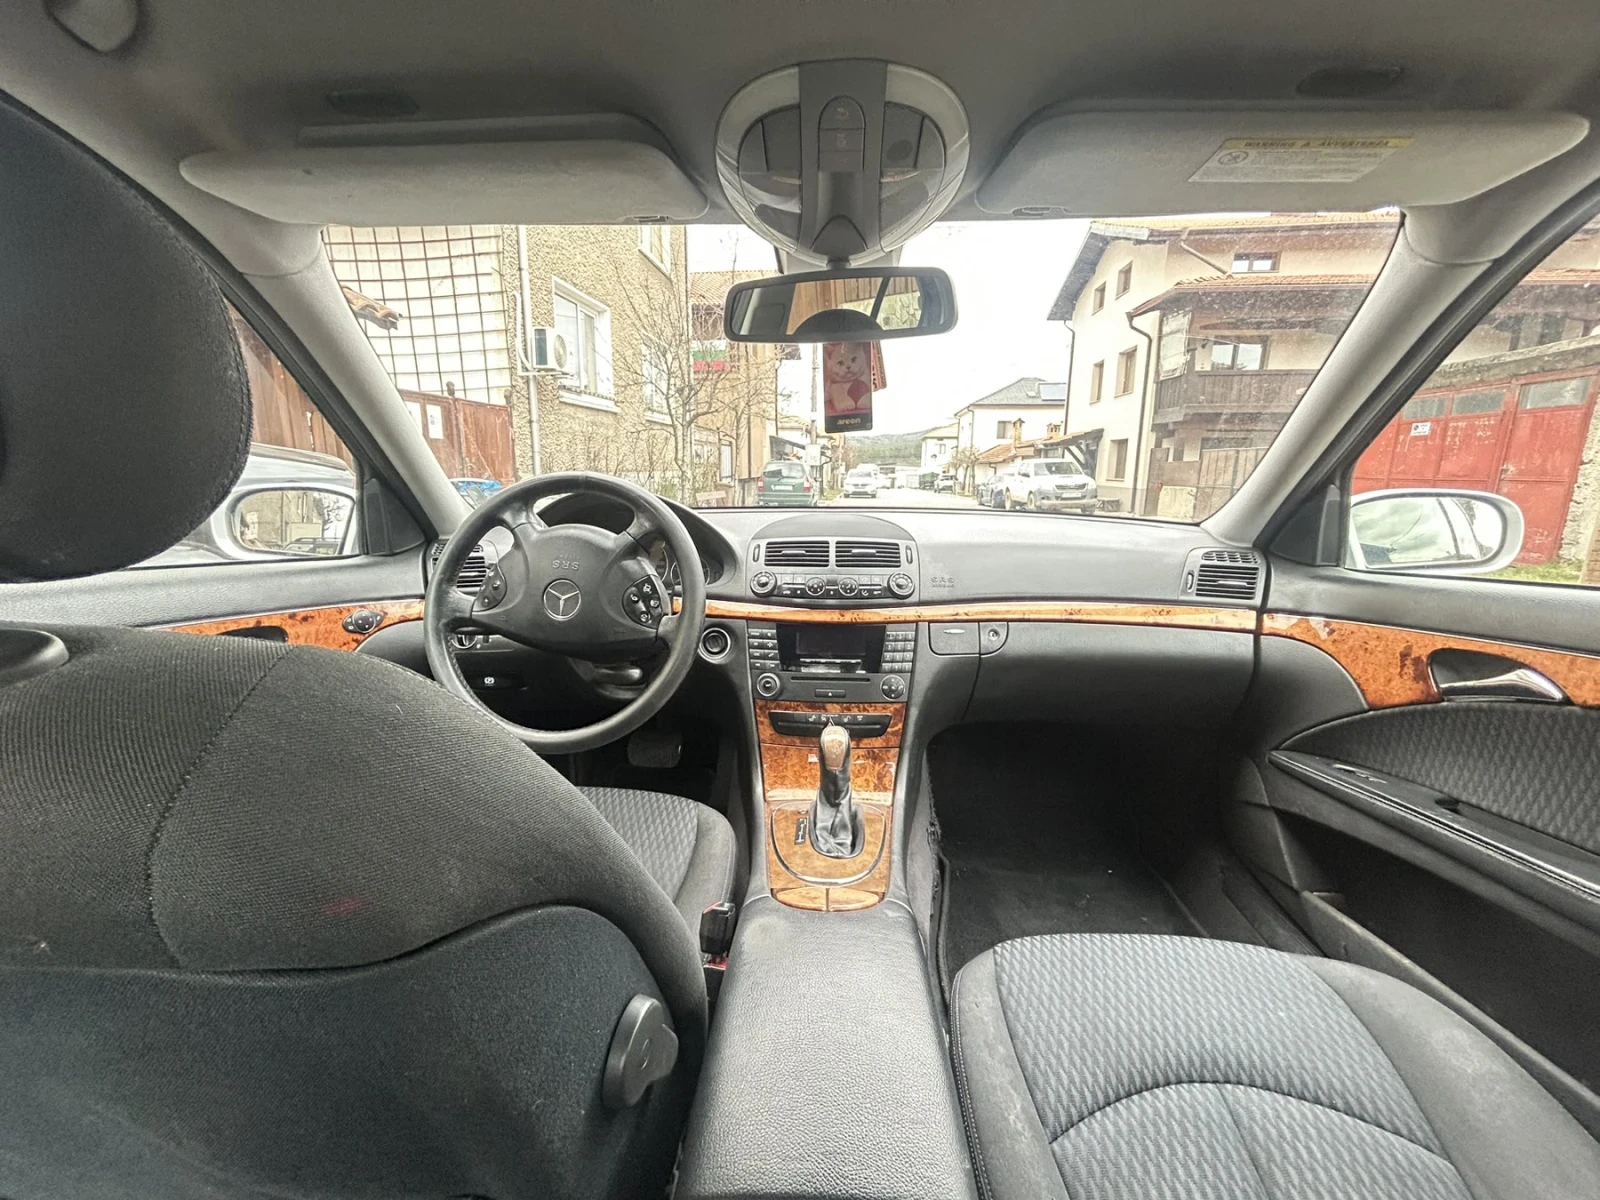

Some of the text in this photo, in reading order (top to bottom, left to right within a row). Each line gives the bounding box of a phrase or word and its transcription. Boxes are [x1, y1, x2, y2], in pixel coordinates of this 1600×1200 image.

[1244, 139, 1295, 147] WARNING
[836, 417, 861, 425] areon
[552, 559, 580, 571] SRS
